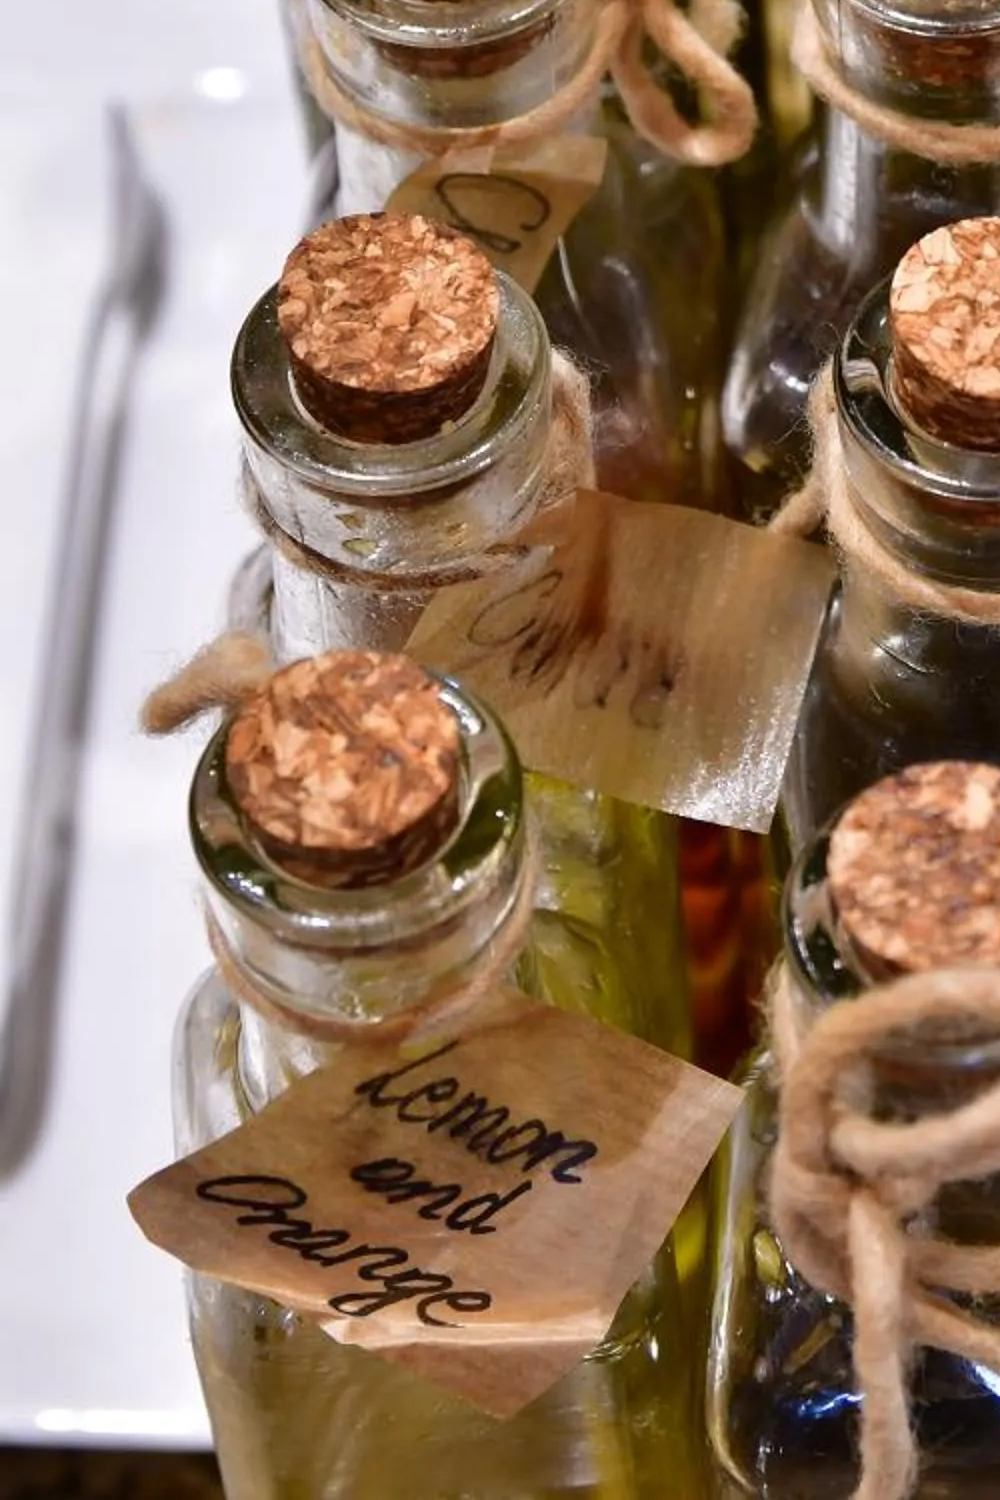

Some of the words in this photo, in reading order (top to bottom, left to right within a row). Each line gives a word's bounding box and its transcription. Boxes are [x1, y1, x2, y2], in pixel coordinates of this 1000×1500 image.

[354, 1039, 599, 1184] Lemon
[195, 1174, 493, 1328] Orange
[350, 1157, 533, 1236] and
